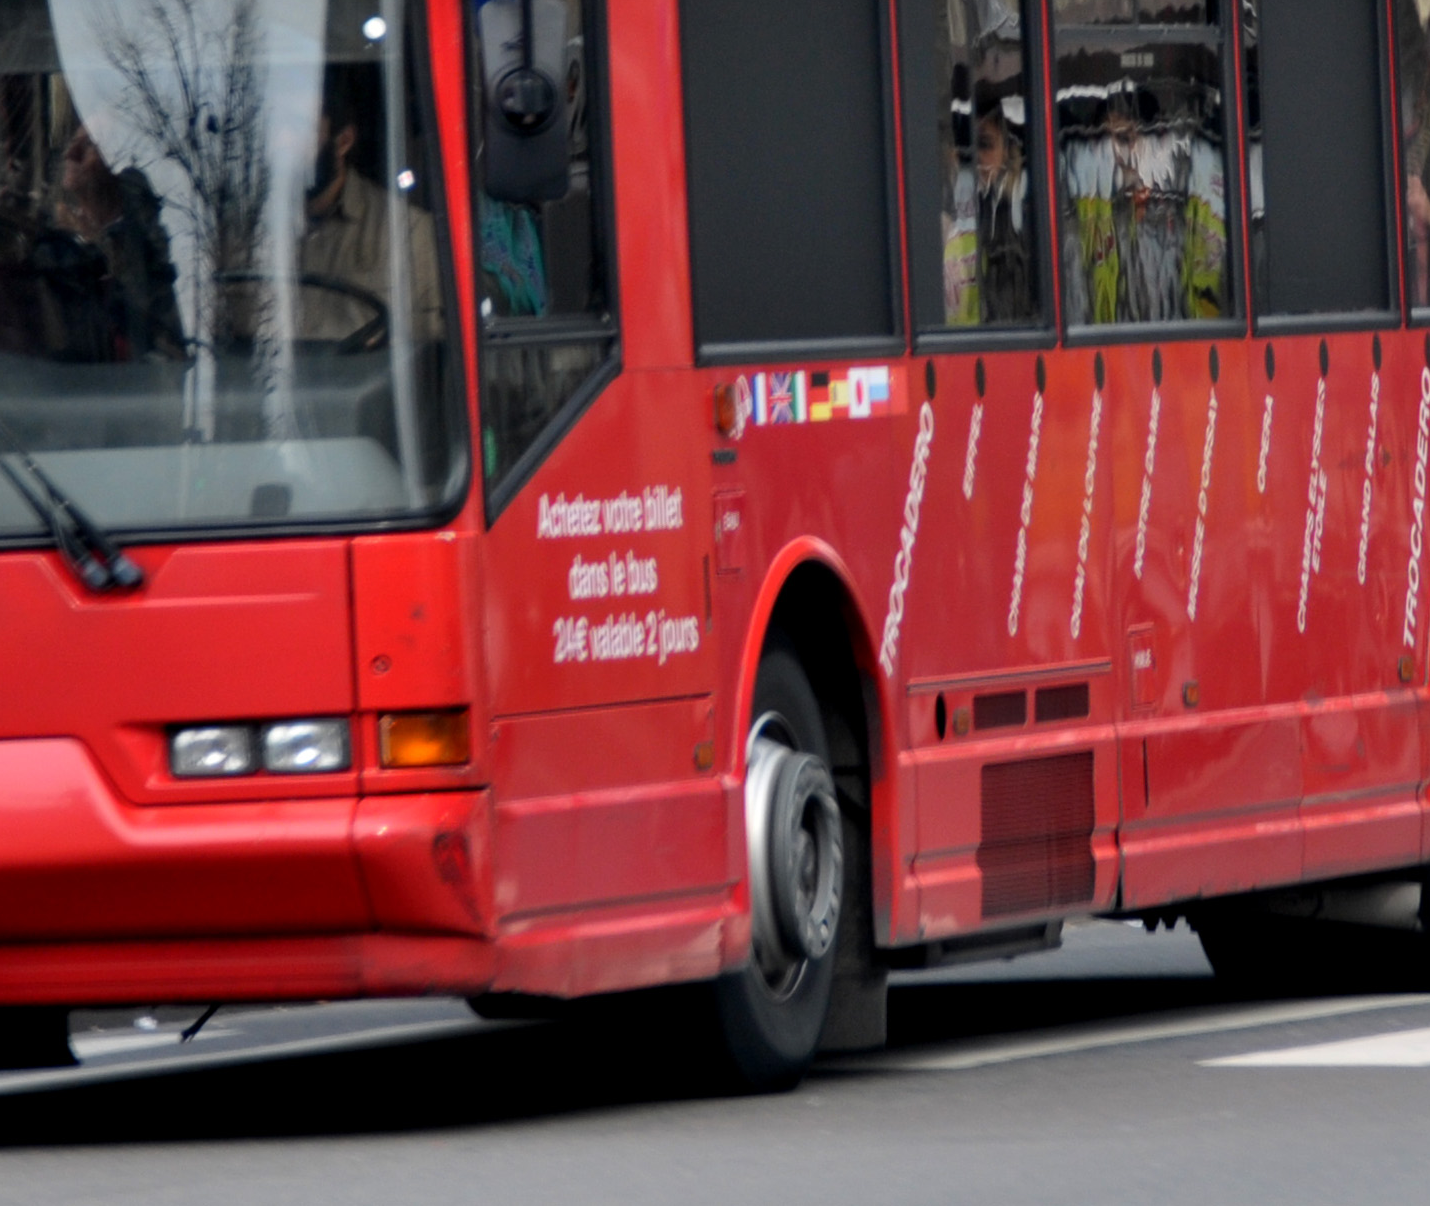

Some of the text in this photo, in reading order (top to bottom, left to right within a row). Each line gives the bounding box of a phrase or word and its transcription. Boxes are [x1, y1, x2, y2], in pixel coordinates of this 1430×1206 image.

[962, 402, 984, 501] EIFFEL
[1133, 386, 1162, 581] NOTRE DAME
[1257, 394, 1275, 494] OPERA
[1357, 370, 1381, 586] GRAND PALAIS
[537, 491, 601, 539] Achetez
[602, 490, 644, 534] votre
[643, 484, 684, 530] billet
[878, 399, 935, 678] TROCADERO
[1007, 390, 1044, 637] CHAMP DE MARS
[1077, 512, 1091, 564] DU
[1297, 376, 1327, 635] CHAMPS ELYSEES
[1311, 466, 1328, 575] ETOILE
[569, 548, 659, 600] dans le bus
[1186, 514, 1206, 623] MUSEE
[591, 611, 646, 660] valable
[645, 610, 659, 656] 2
[659, 607, 701, 666] jours
